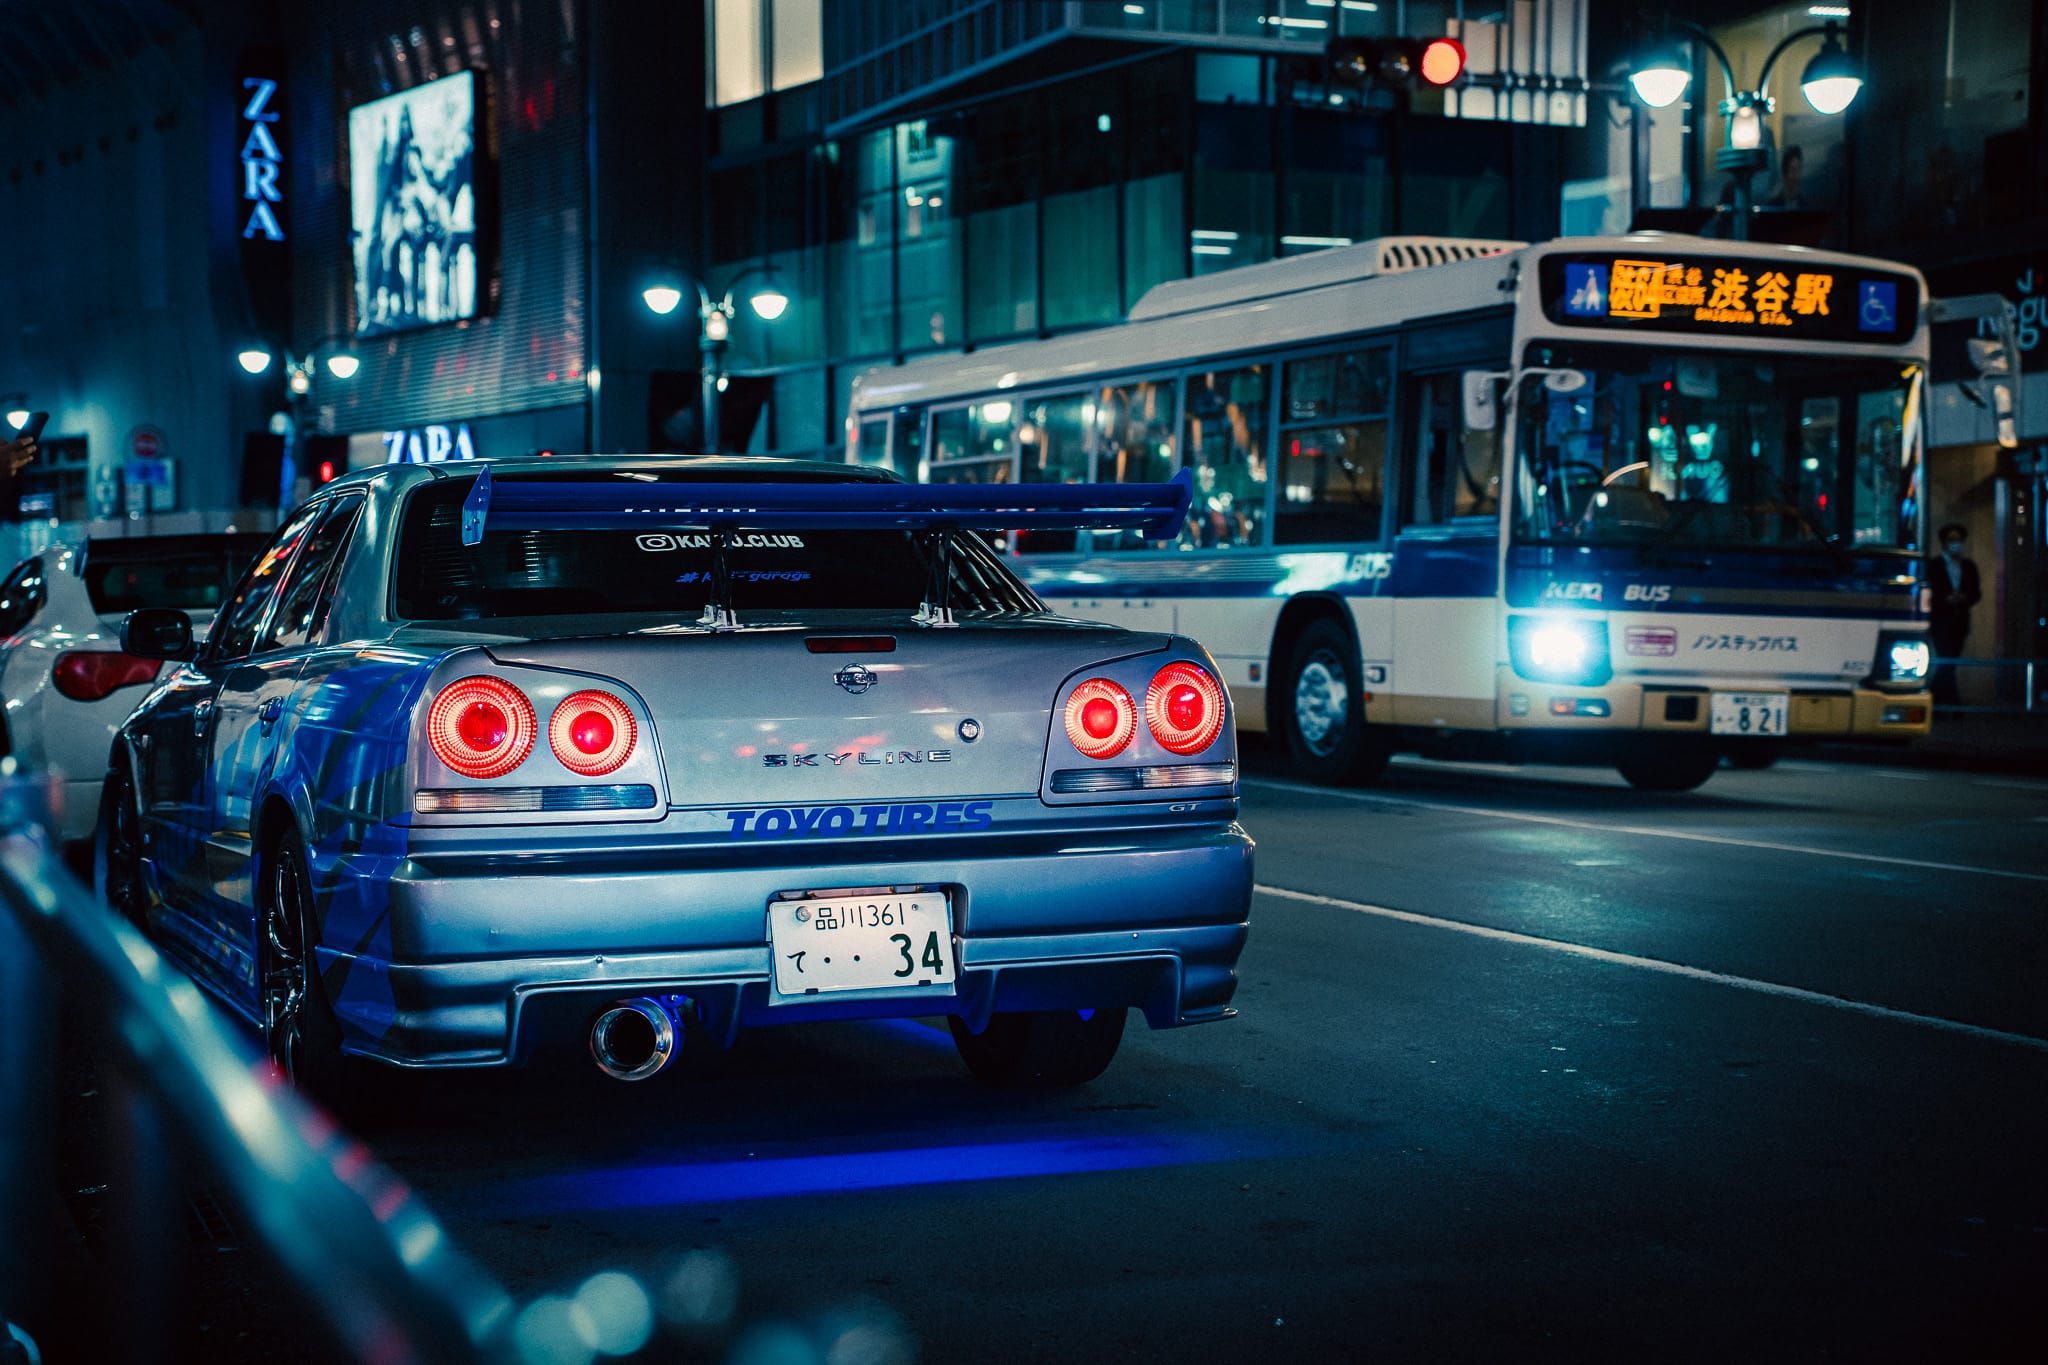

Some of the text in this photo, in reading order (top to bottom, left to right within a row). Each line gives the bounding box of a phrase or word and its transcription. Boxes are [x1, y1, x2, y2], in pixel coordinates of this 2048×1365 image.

[240, 77, 286, 241] ZARA
[1708, 267, 1833, 316] 渋谷駅
[382, 422, 475, 464] ZARA
[1624, 584, 1672, 602] BUS
[1738, 707, 1782, 732] 821
[762, 750, 951, 768] SKYLINE
[1168, 803, 1199, 812] GT
